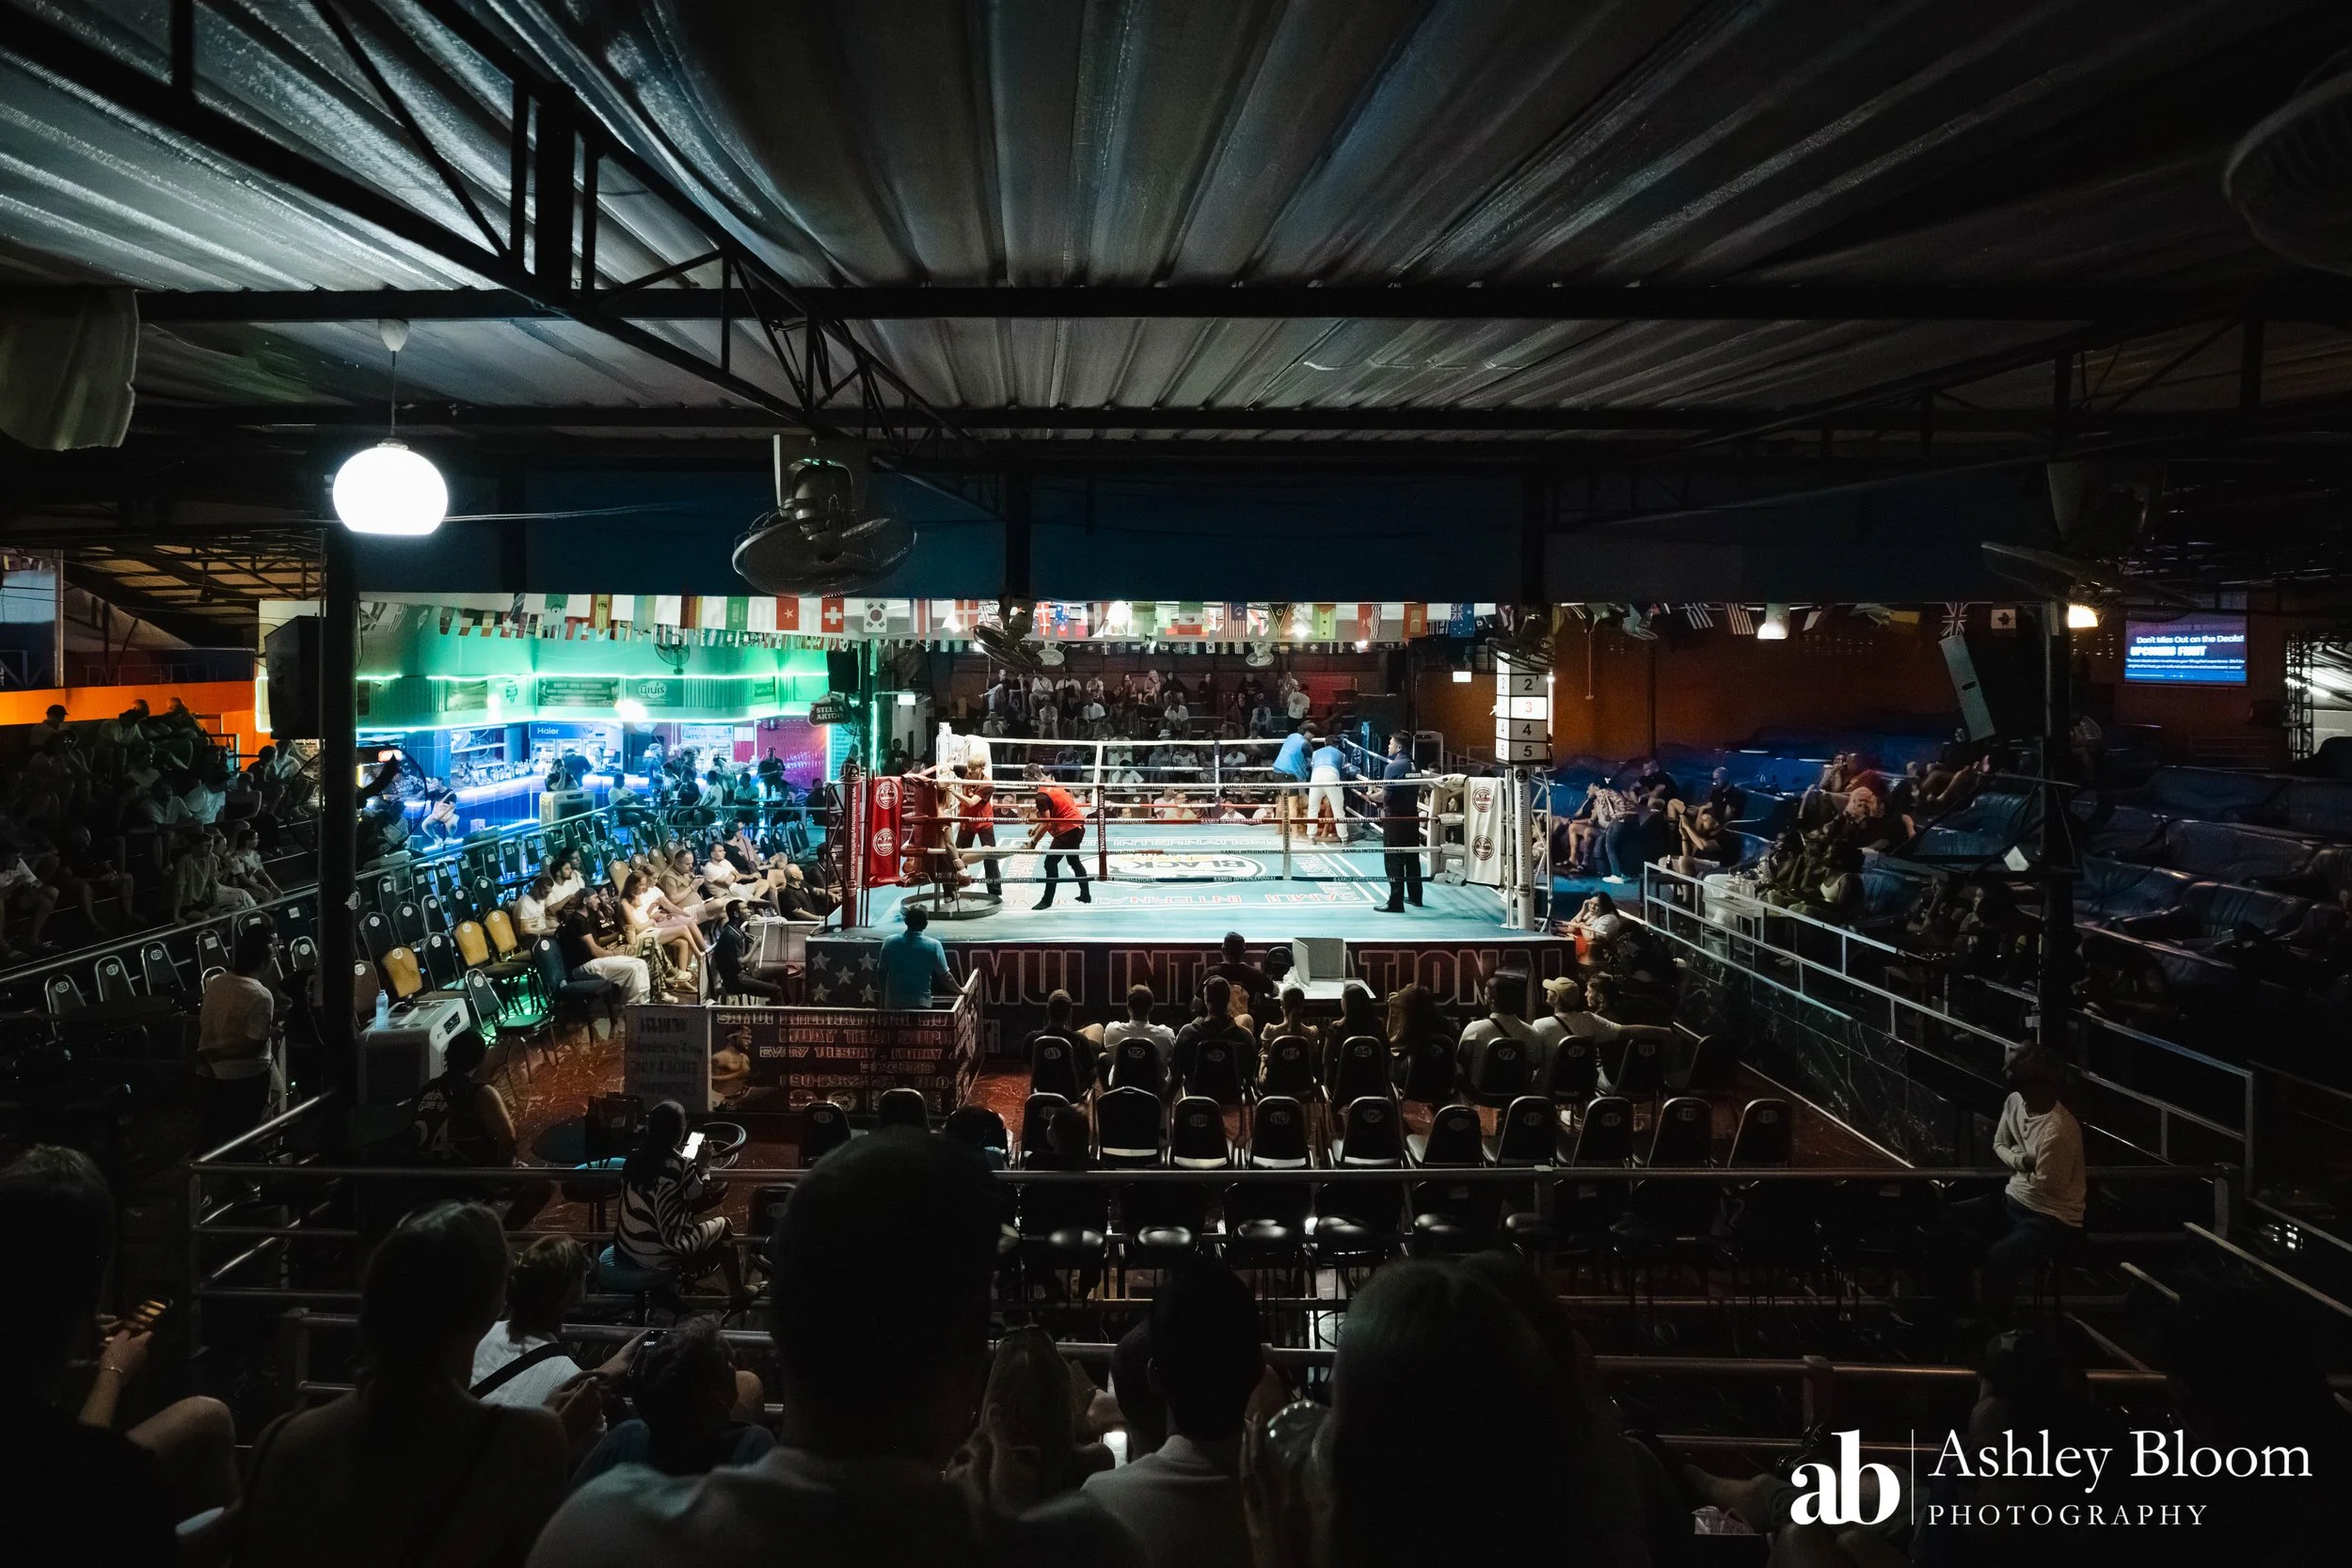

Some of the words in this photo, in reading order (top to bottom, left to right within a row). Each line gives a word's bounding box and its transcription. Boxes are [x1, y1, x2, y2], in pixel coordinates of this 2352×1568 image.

[2201, 635, 2216, 643] the
[1524, 678, 1533, 691] 2
[817, 705, 844, 714] STELA
[1525, 701, 1533, 713] 3
[1522, 722, 1532, 736] 4
[1523, 744, 1533, 757] 5
